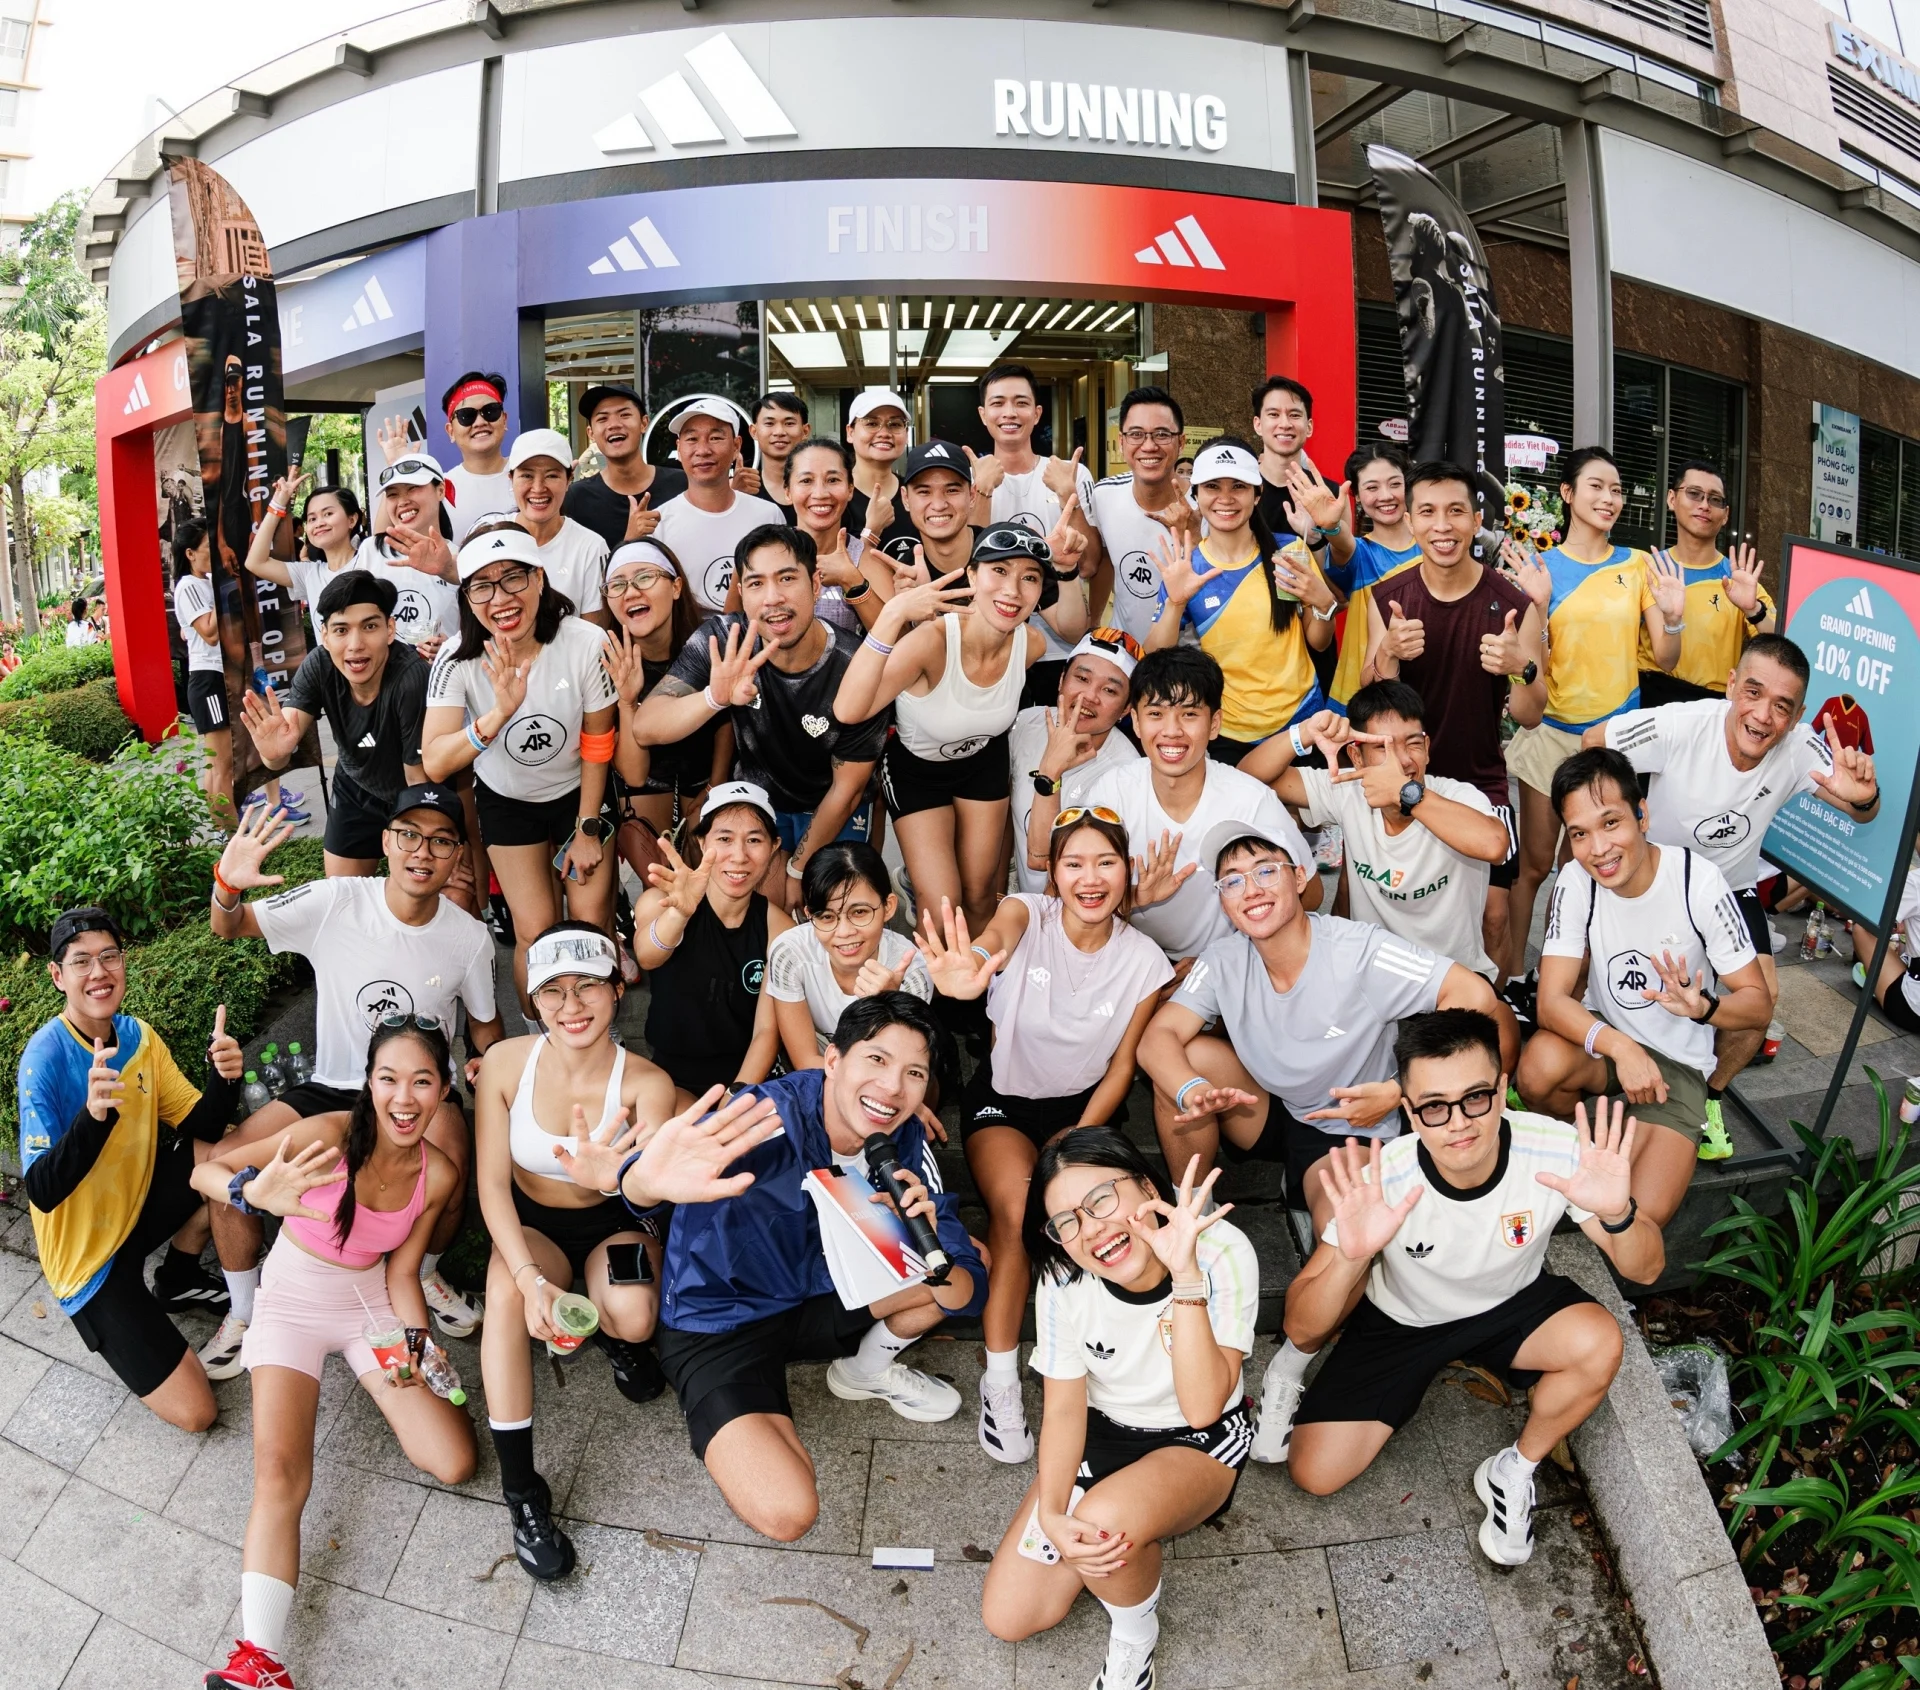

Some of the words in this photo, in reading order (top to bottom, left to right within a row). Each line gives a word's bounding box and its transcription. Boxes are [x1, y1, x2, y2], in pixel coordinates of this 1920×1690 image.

[1826, 21, 1920, 109] EXIM
[994, 79, 1228, 151] RUNNING
[828, 204, 988, 253] FINISH
[243, 276, 262, 347] SALA
[1459, 263, 1482, 330] SALA
[1471, 347, 1485, 472] RUNNING
[246, 365, 270, 502] RUNNING
[1504, 440, 1525, 450] adidas
[292, 452, 300, 464] SA
[1837, 476, 1849, 487] BAY
[1128, 566, 1152, 585] AR
[394, 605, 419, 623] AR
[1820, 614, 1852, 638] GRAND
[1853, 624, 1896, 653] OPENING
[1814, 640, 1851, 681] 10%
[1856, 655, 1893, 695] OFF
[519, 732, 553, 753] AR
[1707, 826, 1736, 840] AR
[1811, 804, 1823, 818] ĐÃI
[1823, 811, 1839, 827] ĐẶC
[1838, 819, 1856, 837] BIỆT
[1413, 874, 1448, 899] BAR
[1617, 970, 1647, 991] AR
